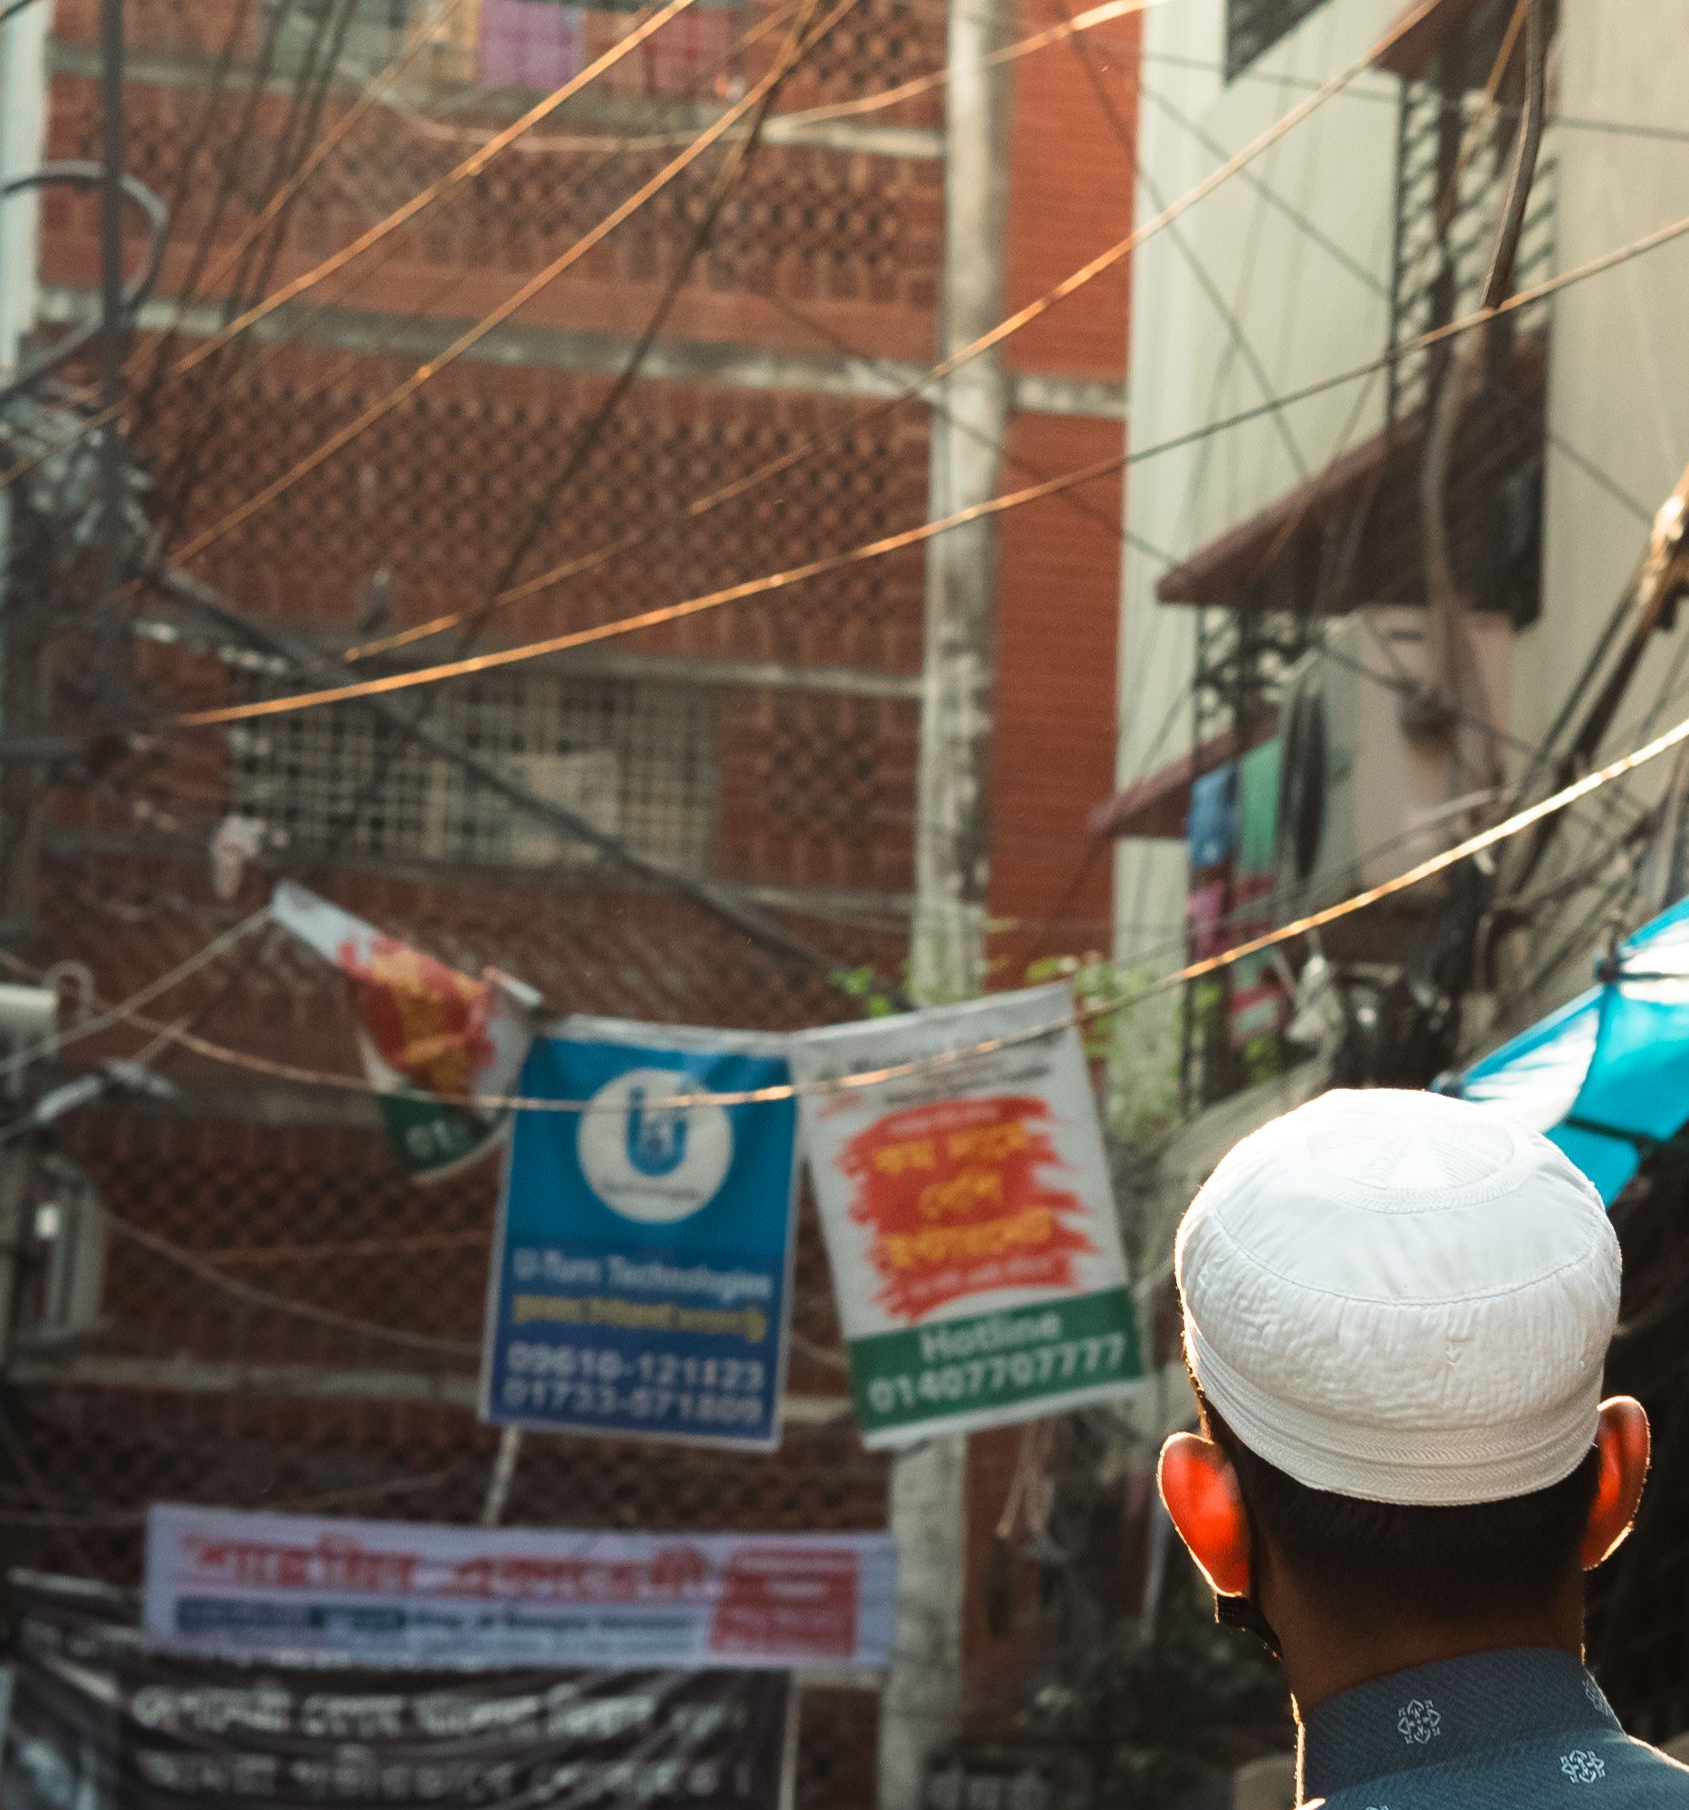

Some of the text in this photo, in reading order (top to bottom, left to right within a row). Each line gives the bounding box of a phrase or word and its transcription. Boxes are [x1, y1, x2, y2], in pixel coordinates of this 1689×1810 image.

[607, 1253, 774, 1302] Technologies
[920, 1312, 1061, 1363] Hotline
[866, 1332, 1125, 1415] 01407707777
